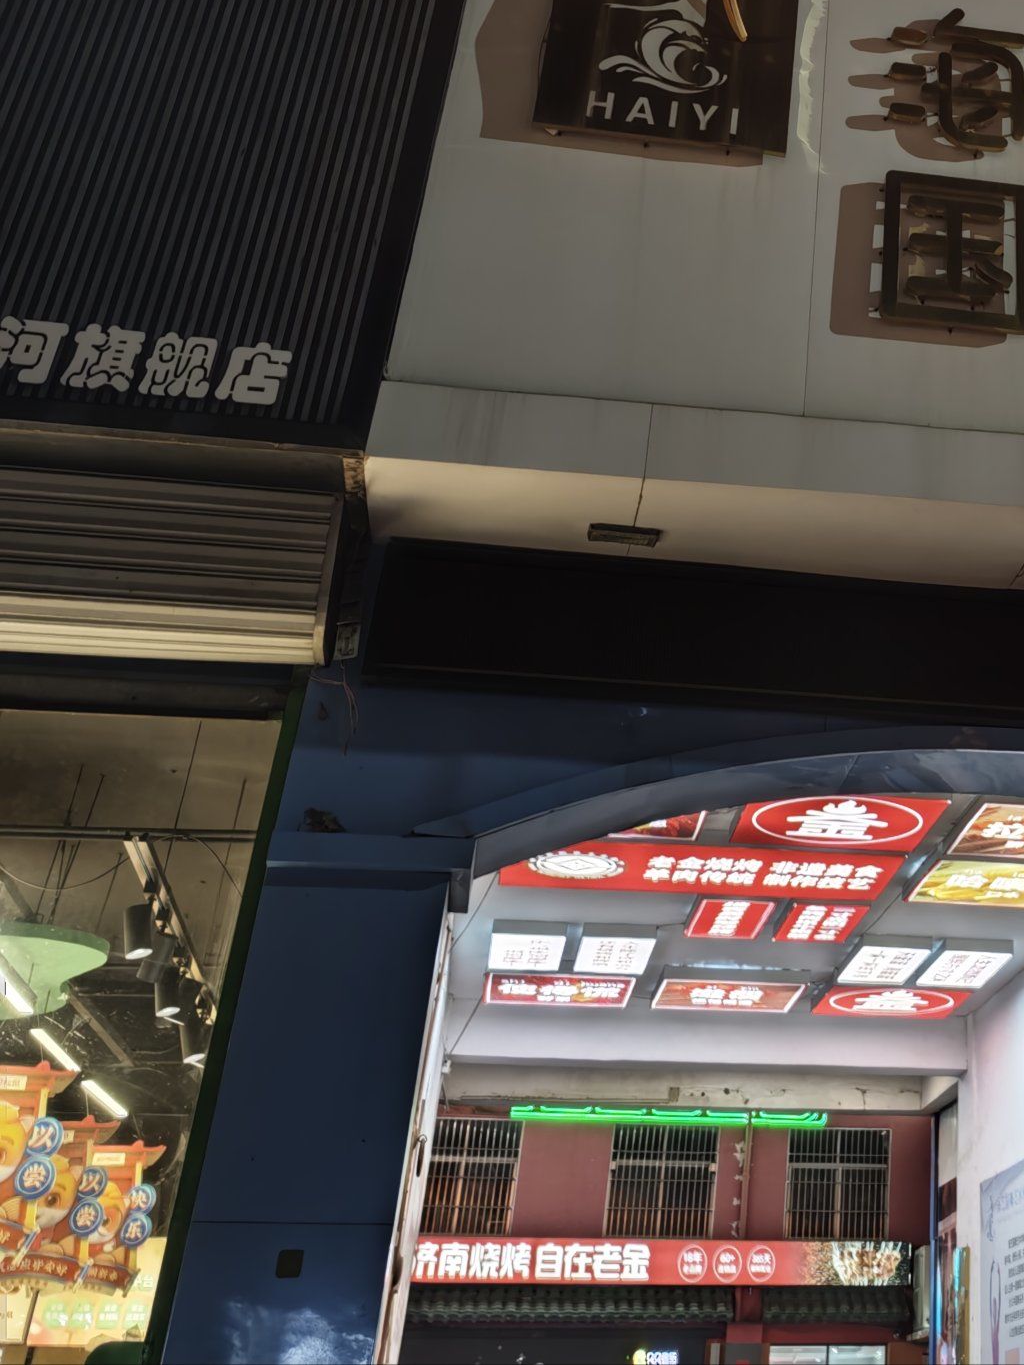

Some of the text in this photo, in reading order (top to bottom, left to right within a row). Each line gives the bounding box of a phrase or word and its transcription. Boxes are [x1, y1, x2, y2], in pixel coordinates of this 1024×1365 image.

[586, 90, 740, 135] HAIYI
[534, 1242, 651, 1280] 自在老金
